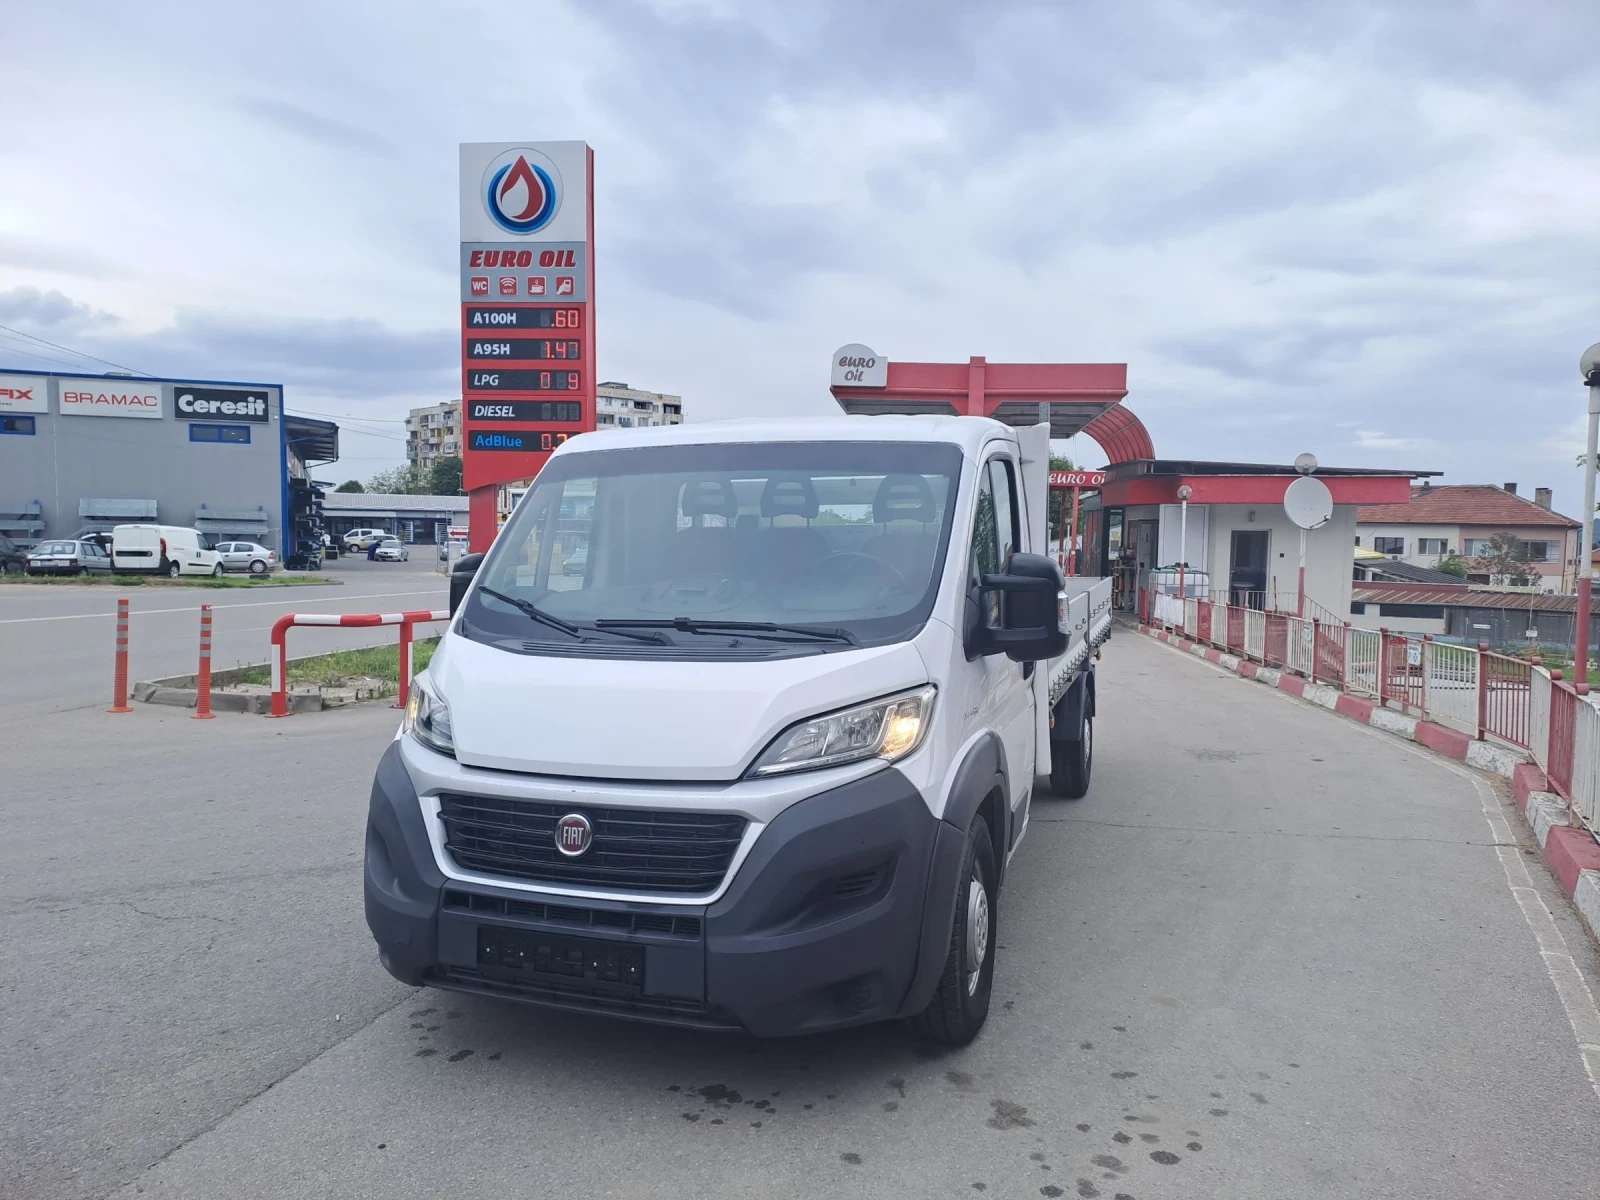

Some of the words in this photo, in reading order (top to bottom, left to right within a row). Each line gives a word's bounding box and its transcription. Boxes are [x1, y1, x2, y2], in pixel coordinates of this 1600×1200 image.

[469, 250, 533, 268] EURO
[539, 250, 577, 268] OIL
[472, 281, 488, 291] WC
[473, 312, 517, 324] A100H
[474, 343, 510, 355] A95H
[474, 374, 499, 386] LPG
[64, 391, 158, 407] BRAMAC
[178, 394, 265, 416] Ceresit
[474, 405, 516, 417] DIESEL
[475, 434, 522, 447] AdBlue
[563, 826, 584, 845] FIAT
